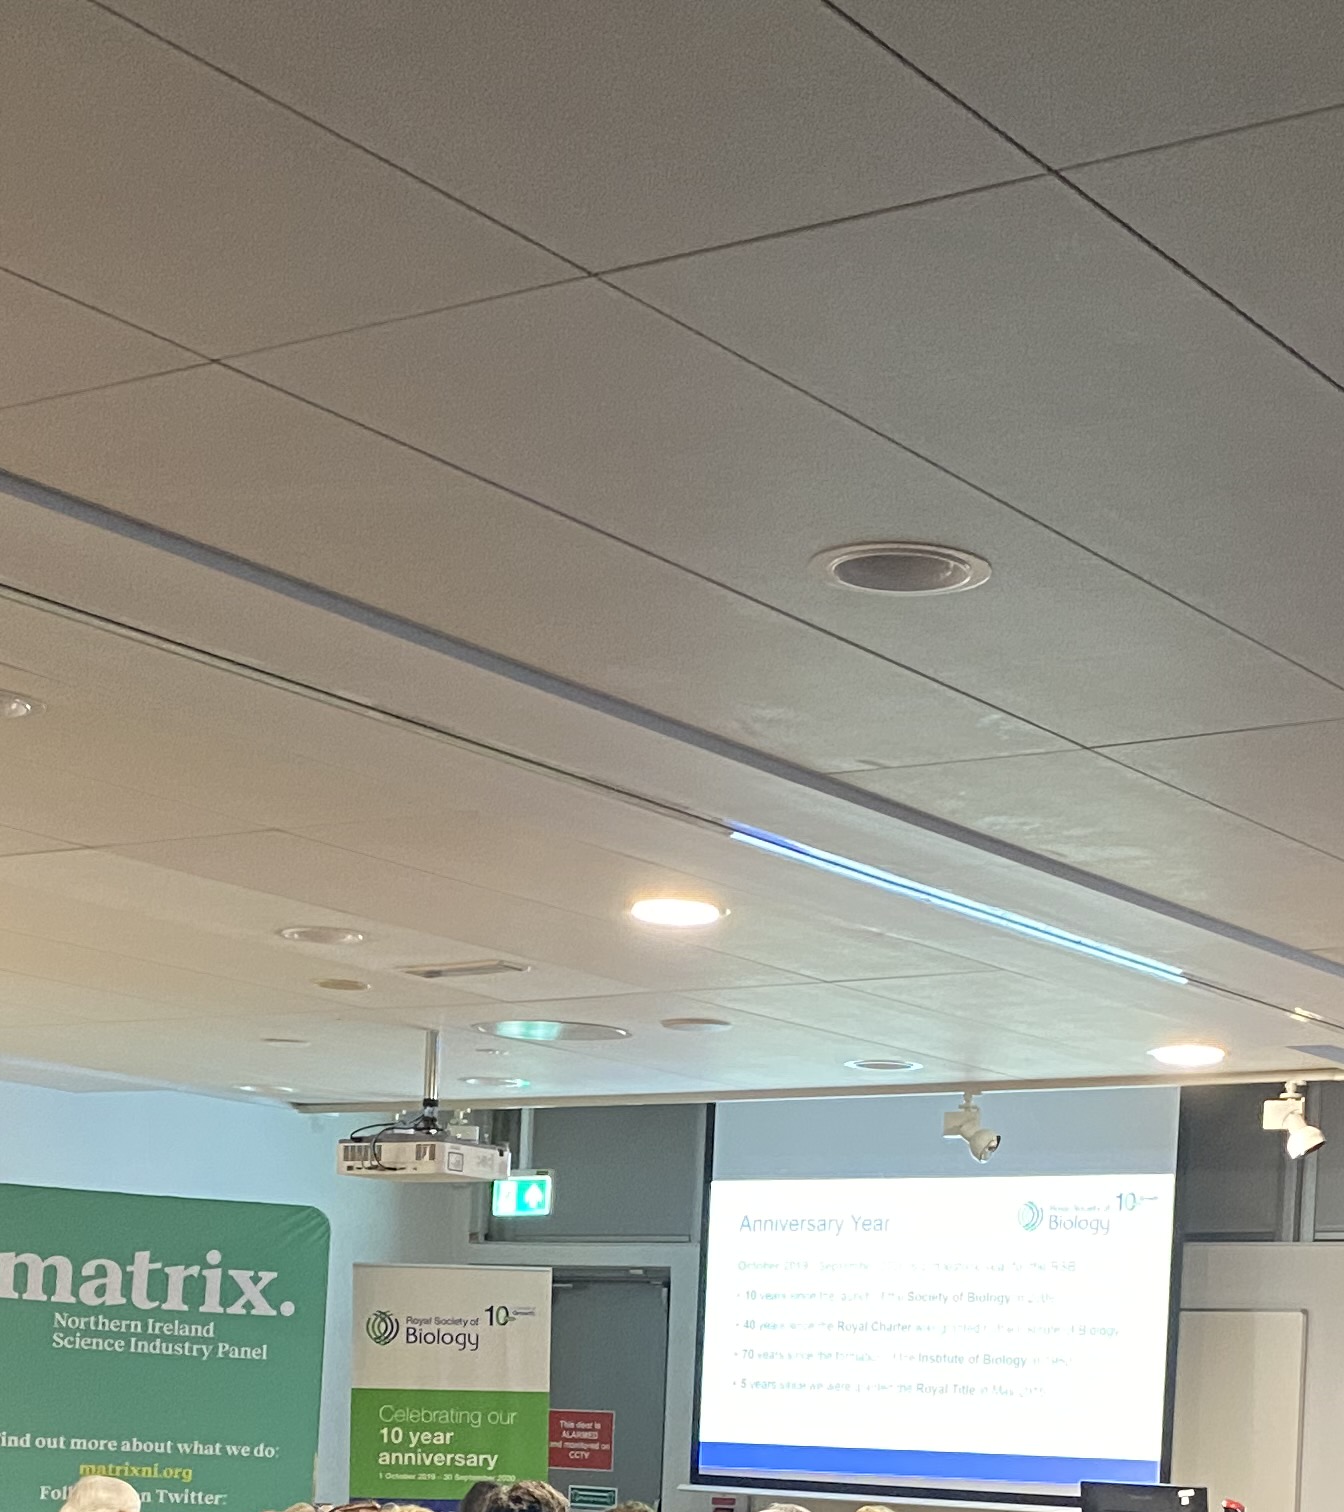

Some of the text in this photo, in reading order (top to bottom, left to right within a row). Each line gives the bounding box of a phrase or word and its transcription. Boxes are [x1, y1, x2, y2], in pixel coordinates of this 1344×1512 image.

[1116, 1192, 1136, 1211] 10
[739, 1215, 890, 1236] Anniversary Year
[1049, 1215, 1109, 1235] Biology
[746, 1290, 757, 1301] 10
[907, 1291, 948, 1305] Society
[952, 1292, 963, 1304] of
[967, 1292, 1010, 1306] Biology
[53, 1312, 215, 1338] Northern Ireland
[406, 1316, 480, 1327] Royal Society of
[484, 1305, 510, 1327] 10
[837, 1320, 868, 1334] Royal
[871, 1321, 912, 1333] Charter
[52, 1332, 268, 1361] Science Industry Panel
[406, 1327, 479, 1351] Biology
[918, 1353, 964, 1366] Institute
[968, 1354, 980, 1365] of
[983, 1354, 1027, 1368] Biology
[916, 1383, 948, 1396] Royal
[953, 1384, 976, 1396] Title
[378, 1404, 517, 1428] Celebrating our
[559, 1420, 575, 1429] This
[34, 1434, 65, 1448] out
[70, 1438, 117, 1451] more
[121, 1438, 172, 1454] about
[177, 1440, 222, 1456] what
[226, 1444, 251, 1457] we
[253, 1442, 280, 1458] do:
[379, 1427, 454, 1448] 10 year
[378, 1449, 499, 1471] anniversary
[568, 1451, 591, 1459] CCTV
[79, 1462, 193, 1483] matrixni.org
[156, 1489, 227, 1505] Twitter:
